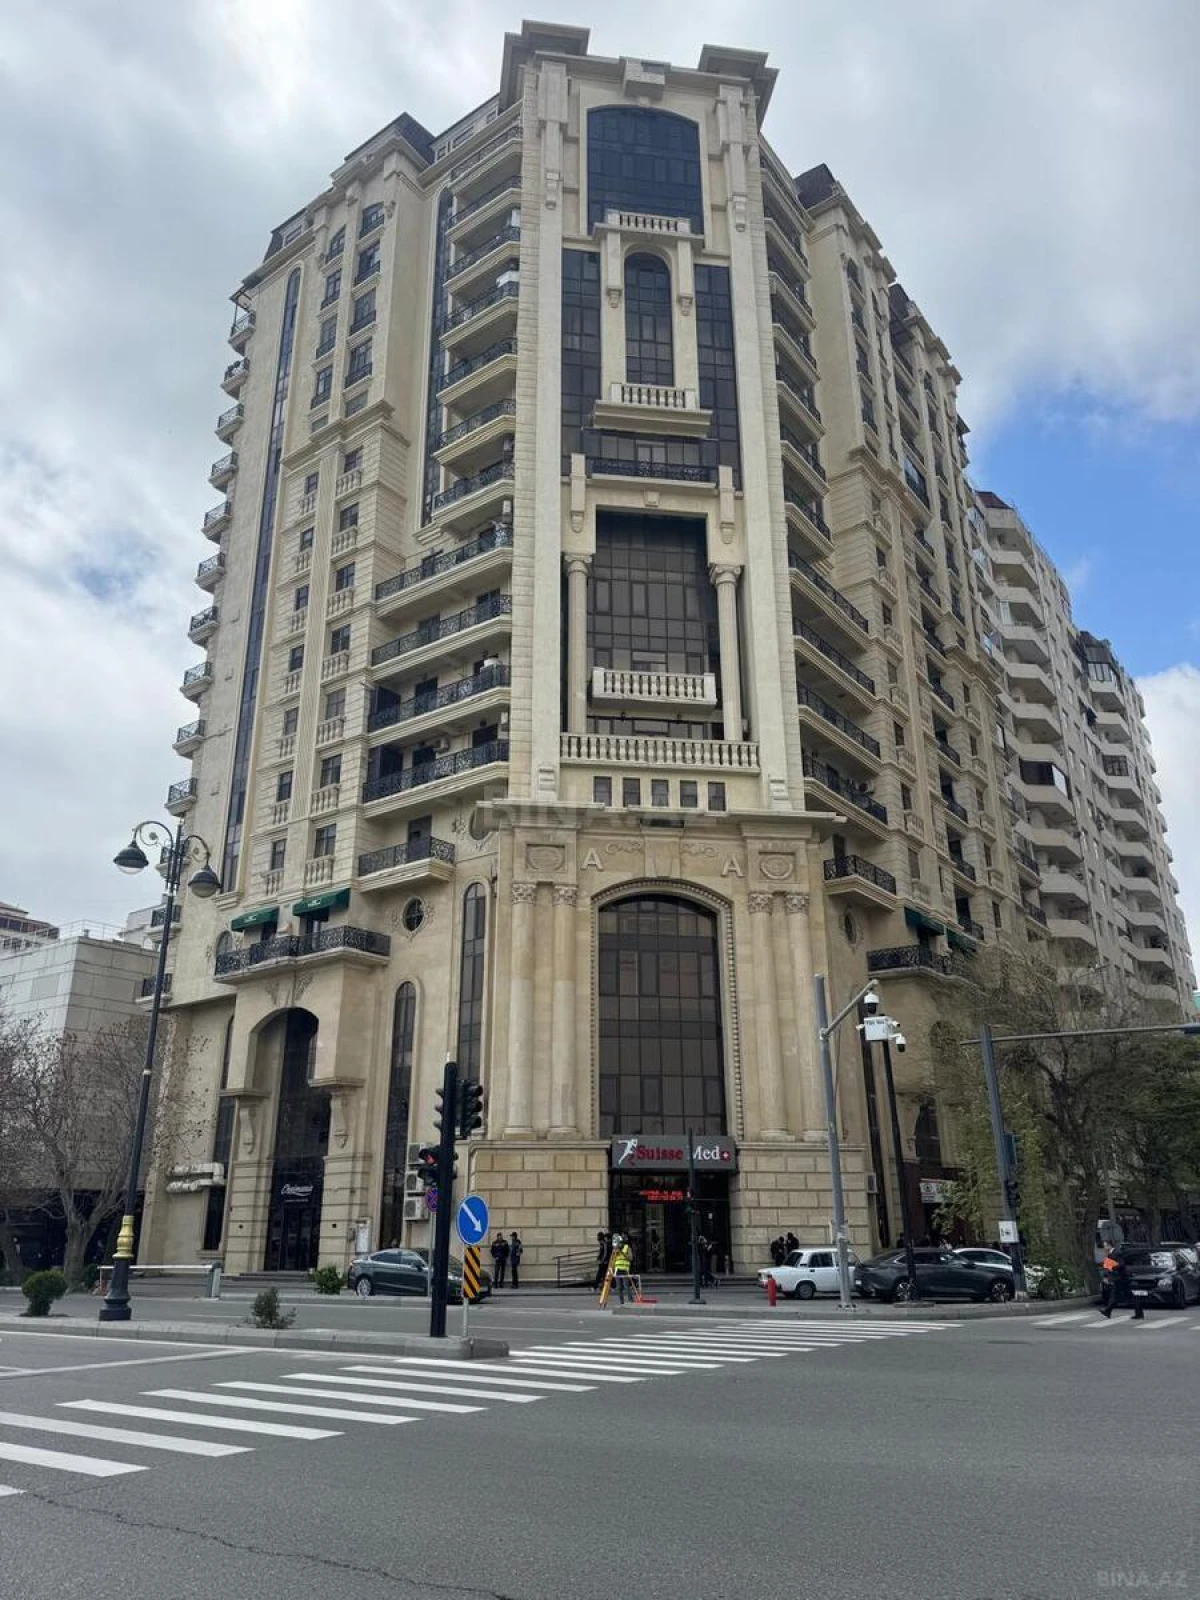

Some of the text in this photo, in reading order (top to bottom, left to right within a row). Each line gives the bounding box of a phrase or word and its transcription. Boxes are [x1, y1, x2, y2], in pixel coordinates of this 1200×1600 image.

[581, 848, 744, 877] A A
[637, 1144, 684, 1160] Suisse
